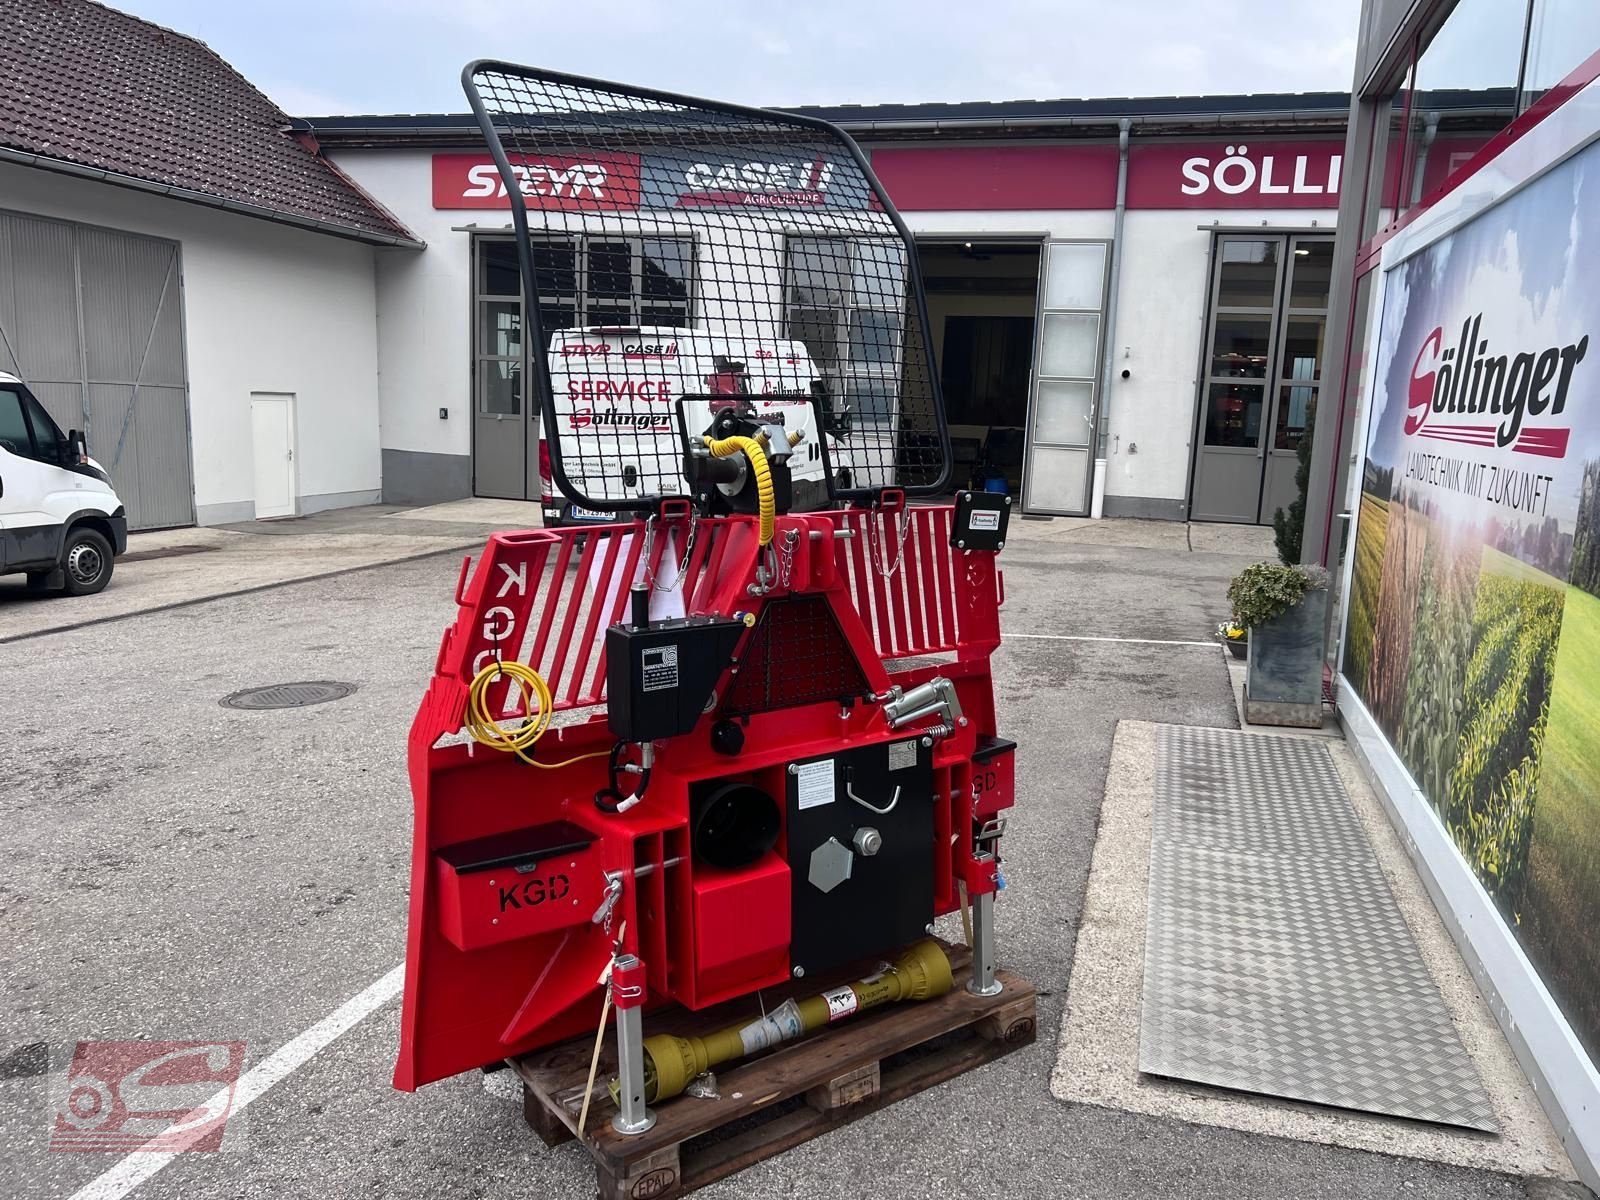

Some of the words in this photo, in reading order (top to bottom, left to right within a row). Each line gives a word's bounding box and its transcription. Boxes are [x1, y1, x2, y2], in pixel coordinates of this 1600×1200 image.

[685, 163, 794, 190] CASE
[744, 194, 819, 205] AGRICULTURE
[624, 344, 664, 354] CASE
[567, 380, 671, 402] SERVICE
[1404, 312, 1589, 448] Söllinger
[1406, 452, 1463, 493] LANDTECHNIK
[1464, 461, 1487, 498] MIT
[1487, 466, 1553, 517] ZUKUNFT
[973, 771, 996, 795] GD
[499, 874, 570, 913] KGD
[638, 1172, 671, 1199] EPAL
